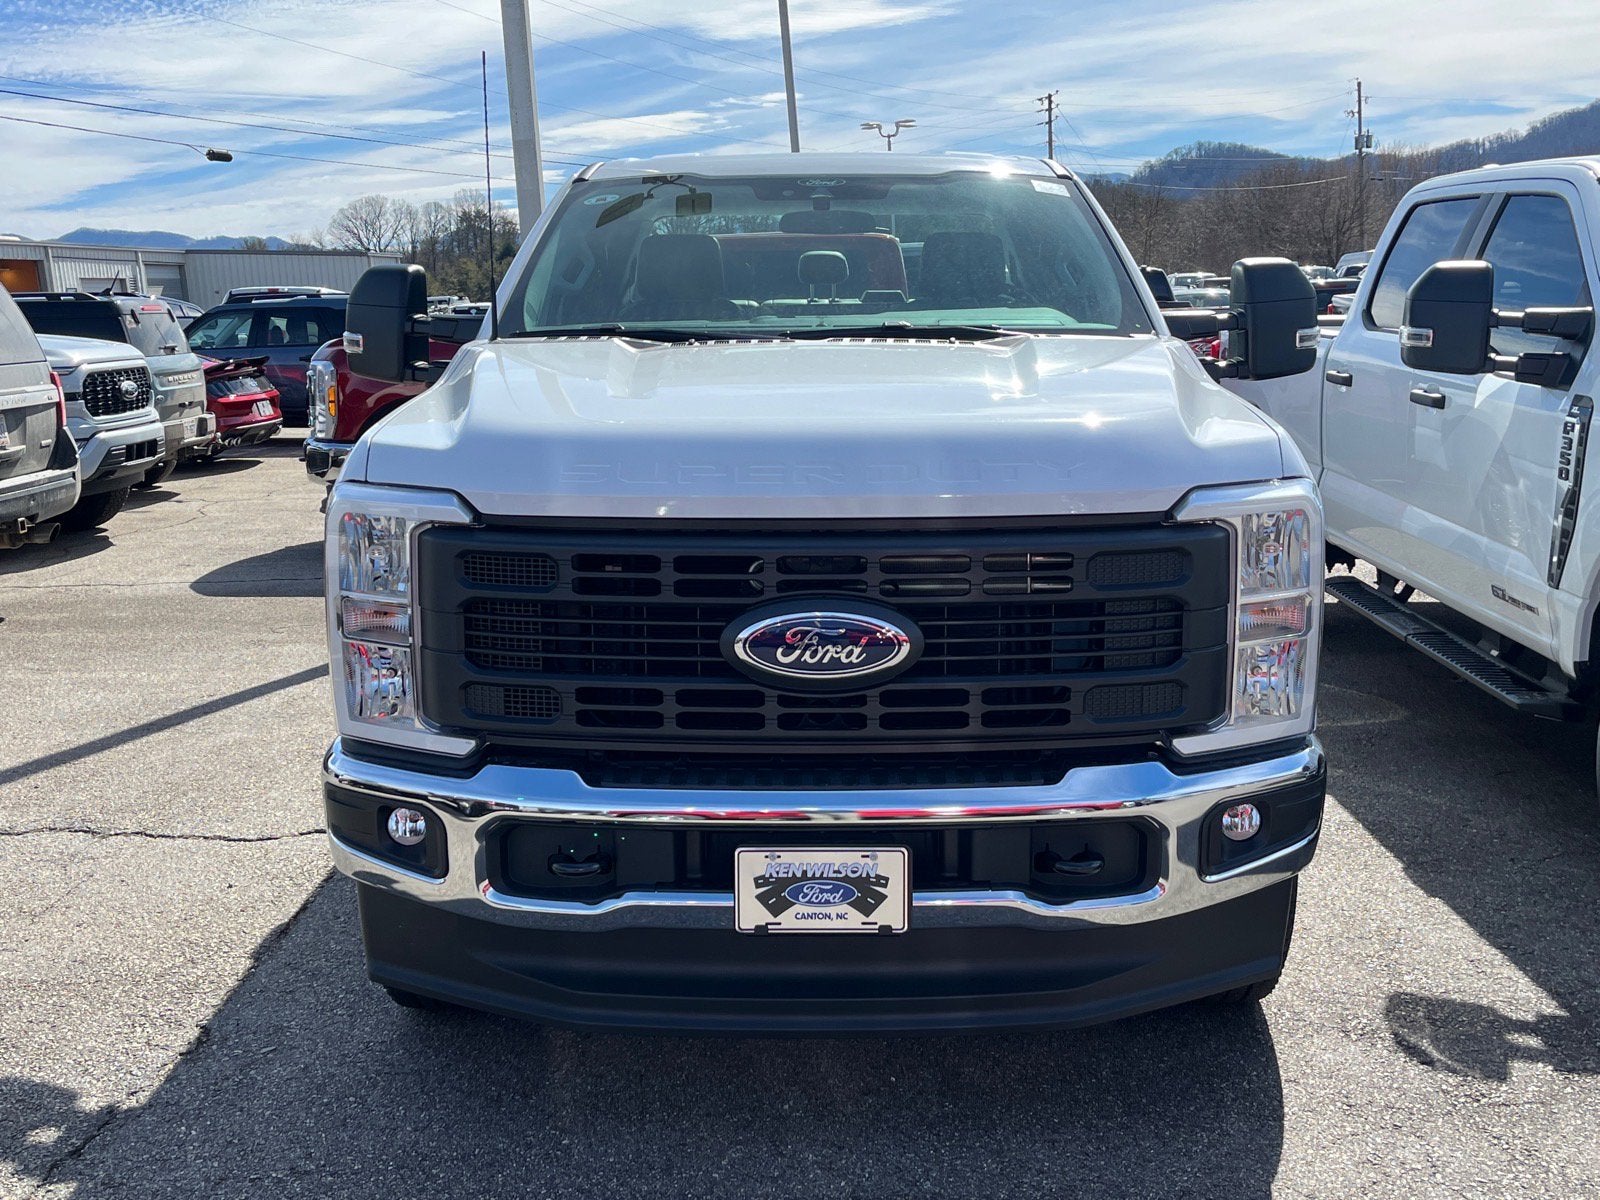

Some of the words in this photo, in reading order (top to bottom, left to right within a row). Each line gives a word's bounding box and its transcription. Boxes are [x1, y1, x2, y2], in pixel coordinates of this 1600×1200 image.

[560, 462, 846, 485] SUPER
[862, 459, 1087, 484] DUTY
[776, 626, 867, 664] Ford
[765, 862, 805, 878] KEN
[805, 862, 878, 878] WILSON
[799, 884, 844, 903] Ford
[794, 912, 834, 921] CANTON,
[836, 912, 849, 920] NC
